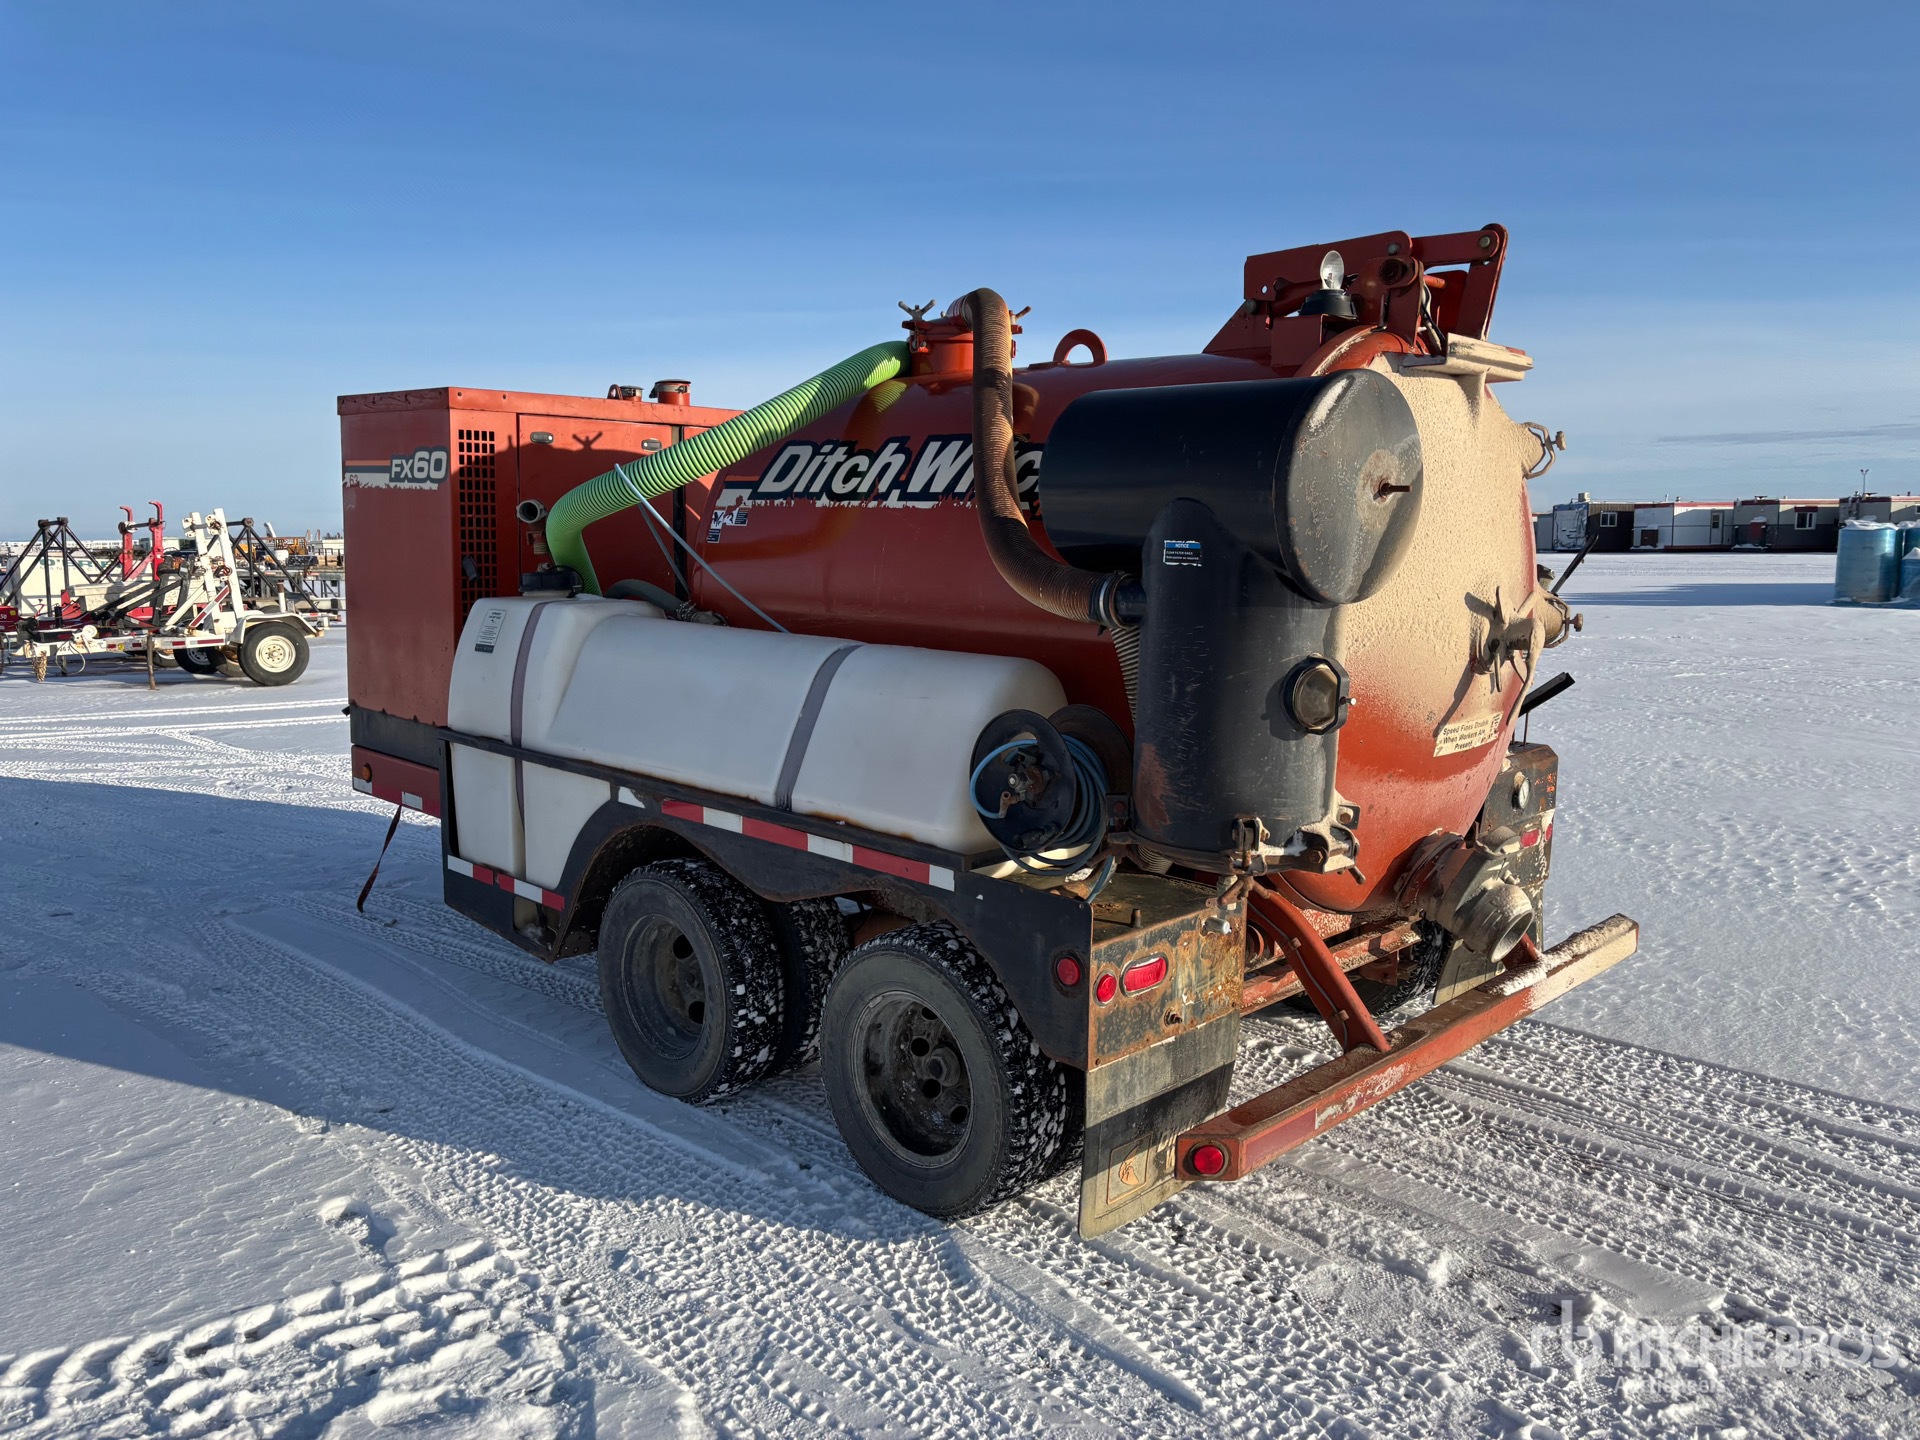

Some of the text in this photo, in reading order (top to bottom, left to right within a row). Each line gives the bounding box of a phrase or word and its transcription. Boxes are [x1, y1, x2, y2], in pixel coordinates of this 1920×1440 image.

[391, 450, 447, 479] FX60
[757, 442, 906, 495] Ditch
[1443, 725, 1460, 736] Speed
[1460, 723, 1474, 732] Fines
[1443, 736, 1458, 745] When
[1458, 731, 1478, 741] Workers
[1478, 728, 1486, 736] Are
[1454, 740, 1473, 751] Present
